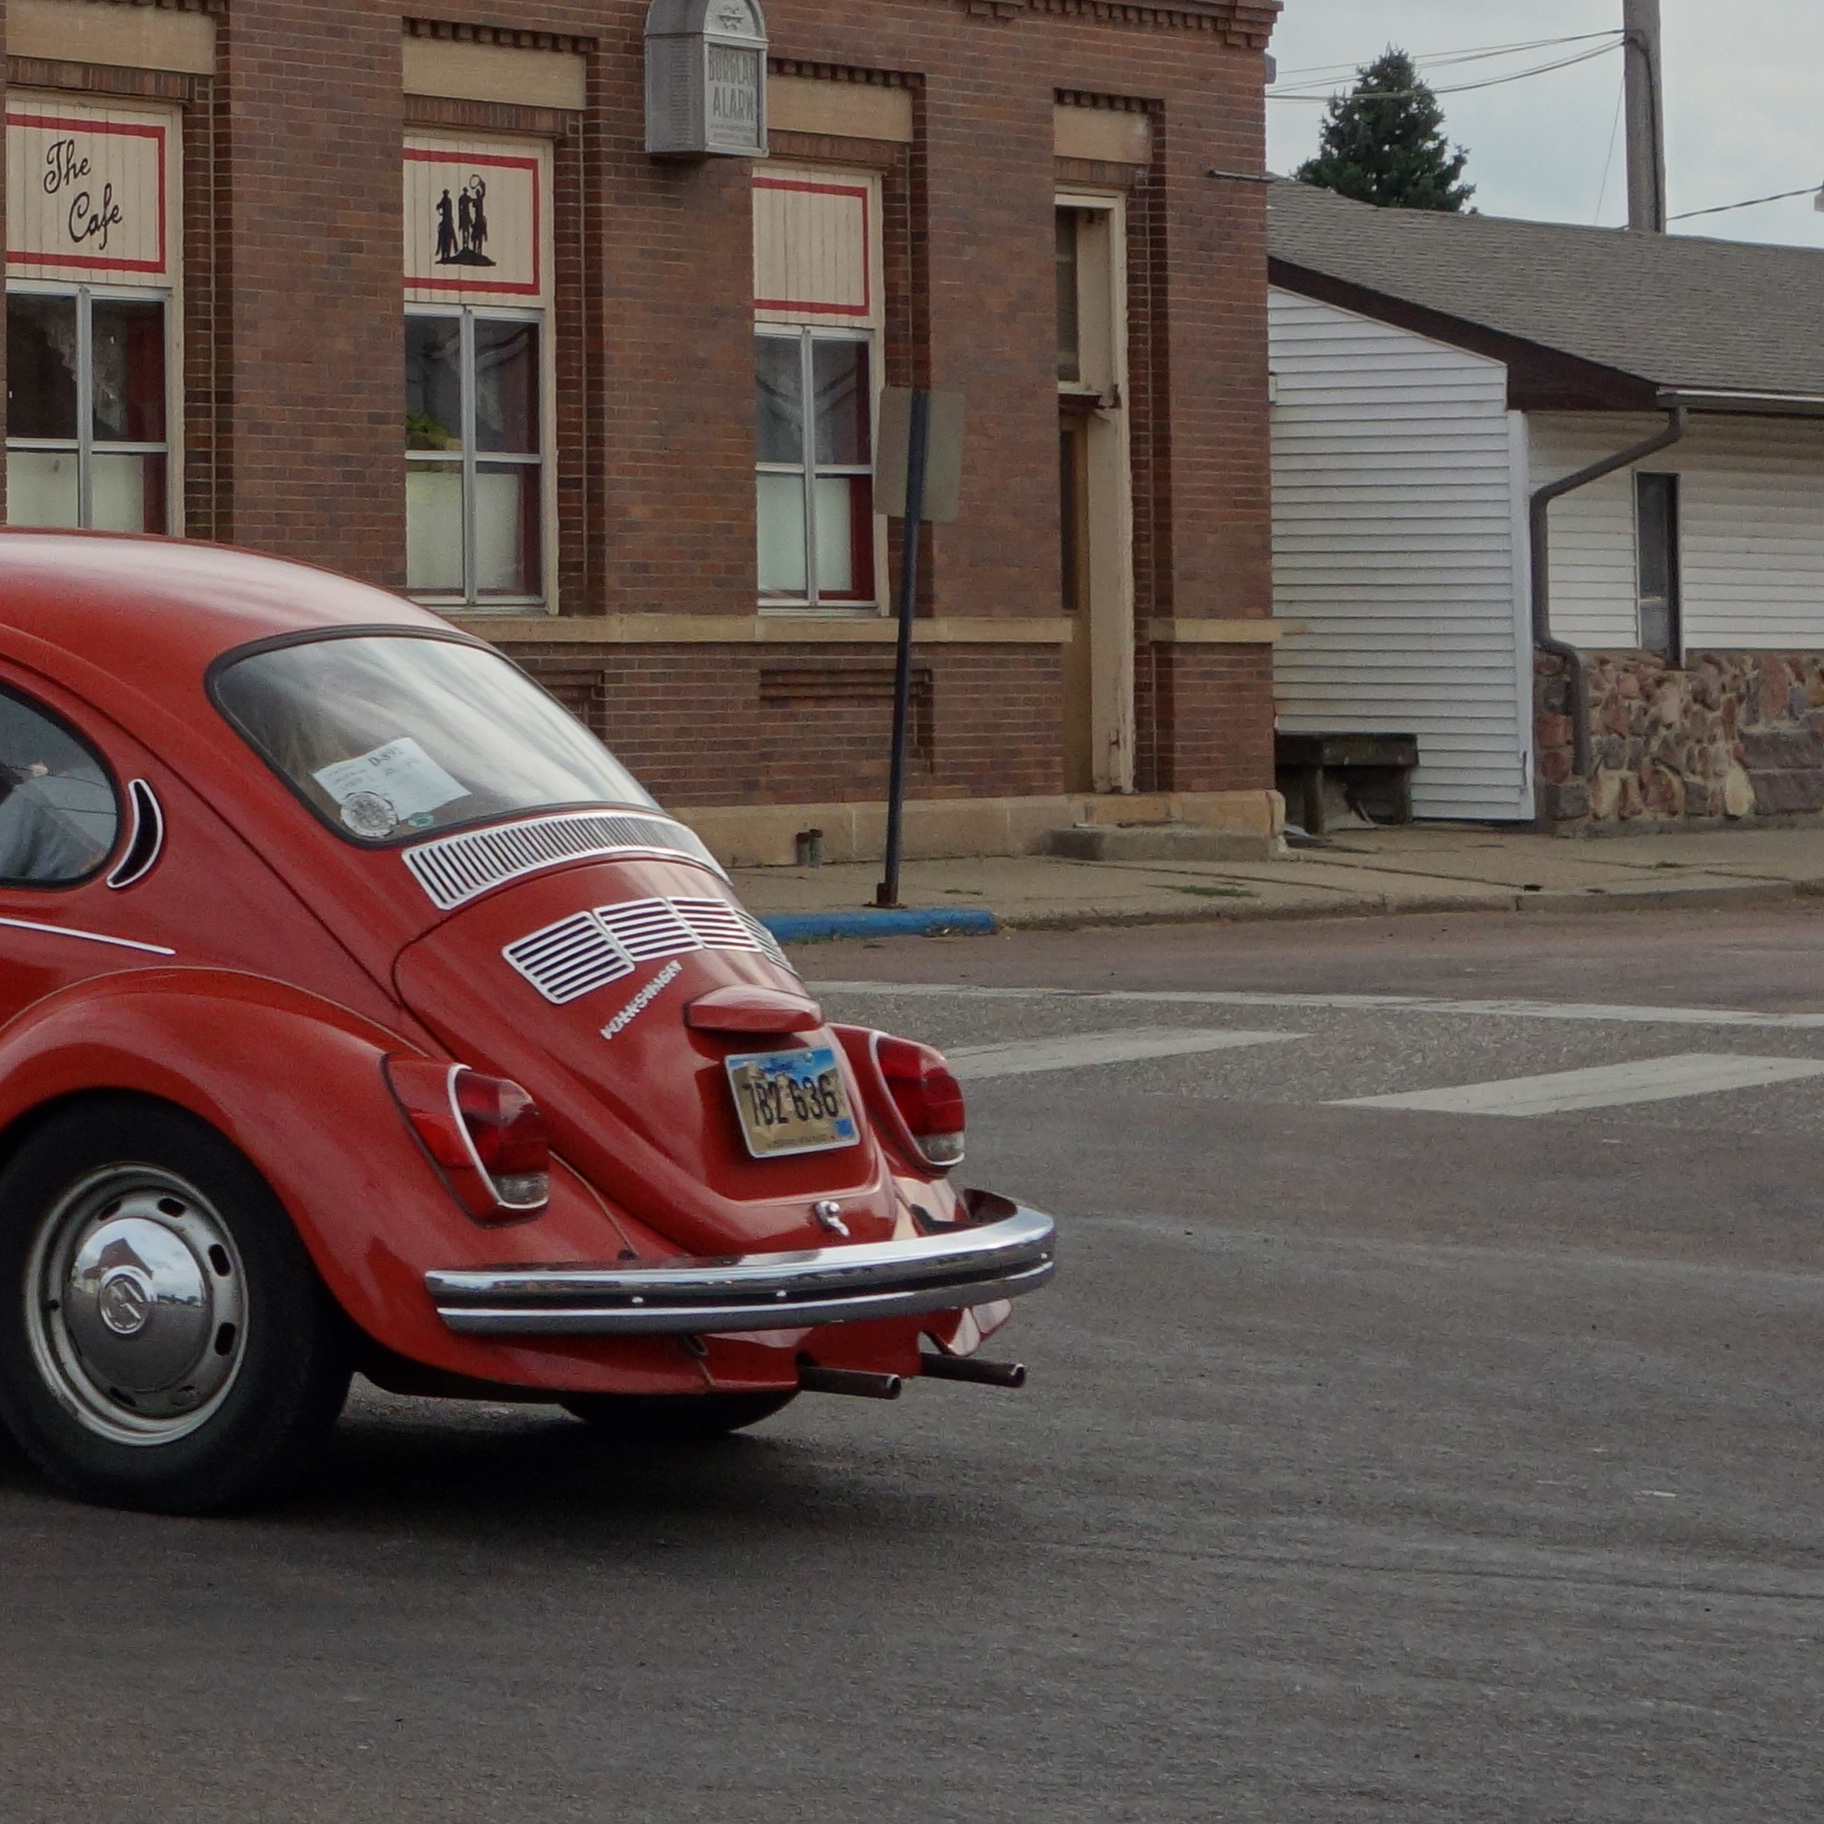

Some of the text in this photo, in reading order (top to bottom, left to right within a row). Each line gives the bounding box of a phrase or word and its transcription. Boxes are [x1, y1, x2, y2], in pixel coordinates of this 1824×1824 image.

[713, 85, 756, 121] ALARM
[42, 138, 92, 194] The
[67, 182, 123, 251] Cafe
[599, 959, 683, 1041] VOLKSWAGEN
